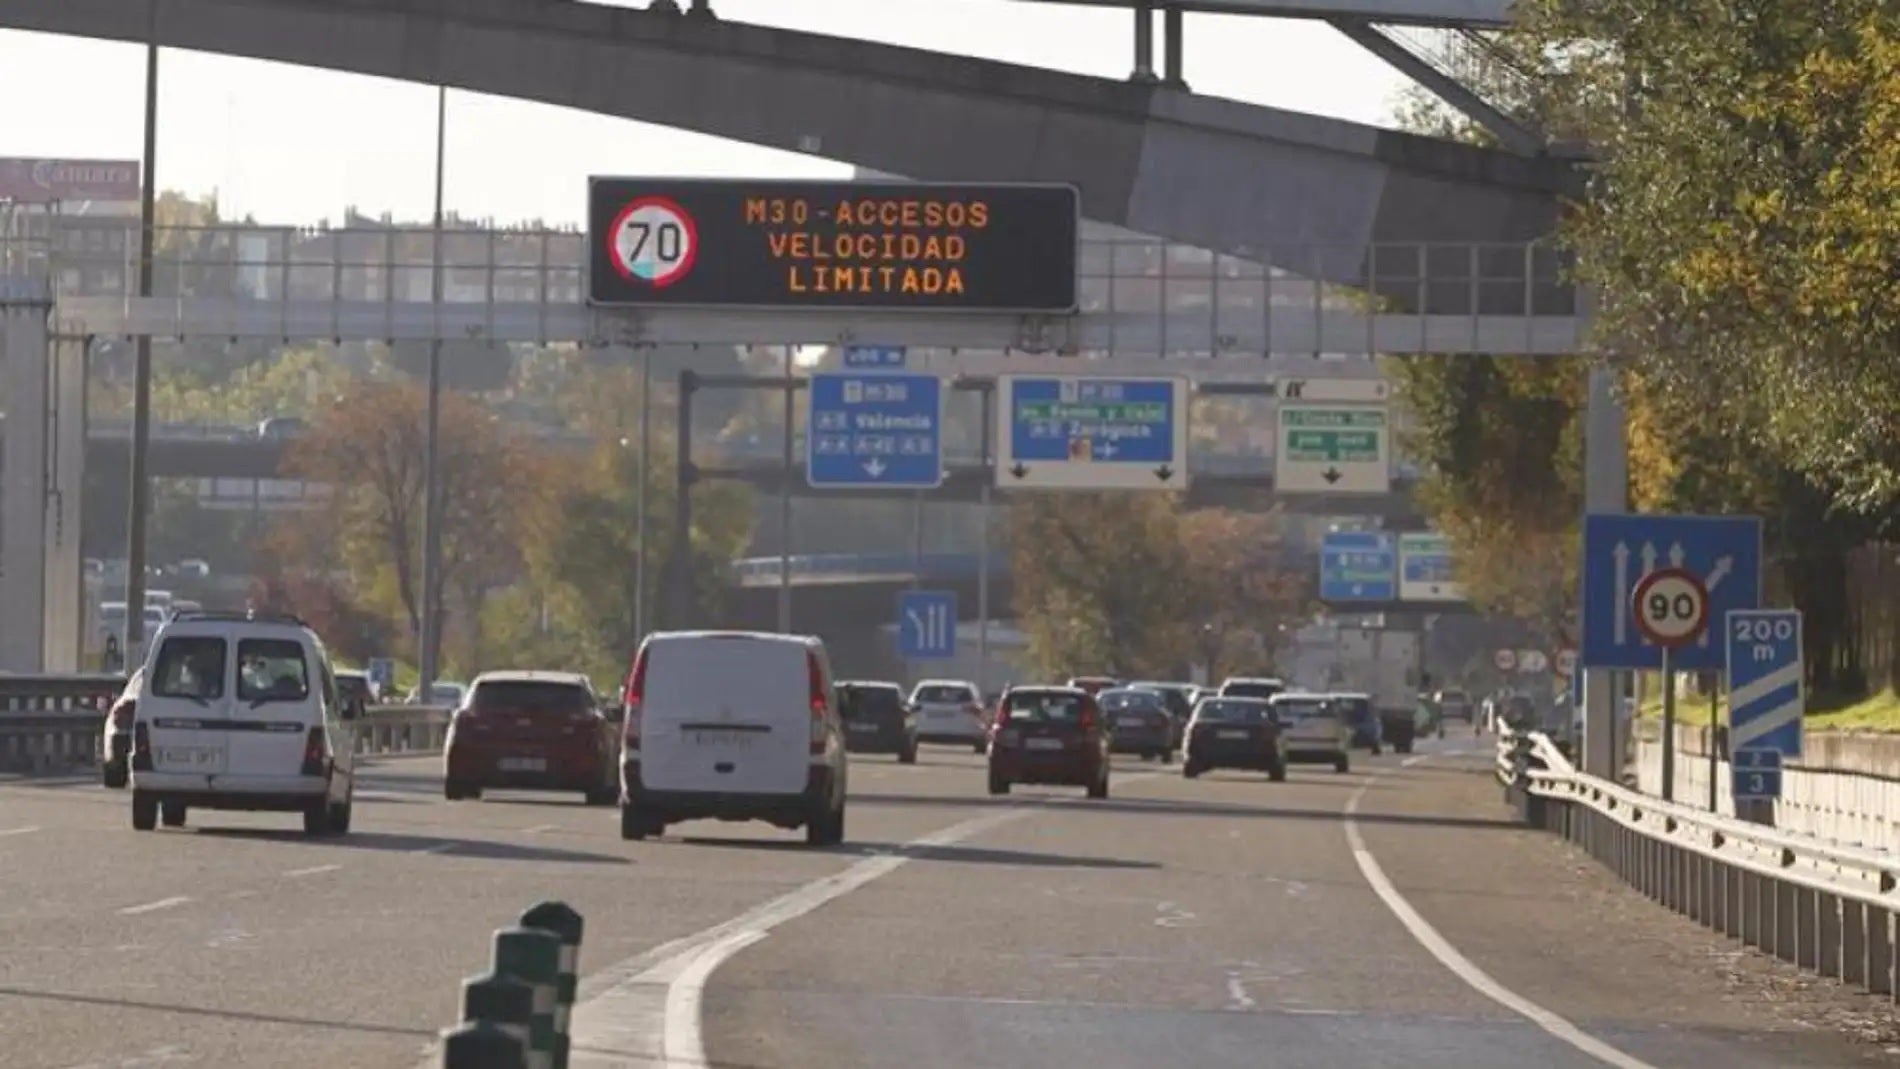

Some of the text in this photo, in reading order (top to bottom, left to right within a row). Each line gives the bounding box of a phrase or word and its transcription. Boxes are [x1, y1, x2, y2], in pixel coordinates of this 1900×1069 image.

[626, 221, 680, 262] 70
[768, 232, 965, 259] VELOCIDAD
[789, 266, 965, 293] LIMITADA
[855, 412, 932, 429] Valencia
[1650, 593, 1694, 620] 90
[1735, 619, 1793, 641] 200
[1753, 645, 1775, 661] m
[1750, 774, 1765, 793] 3
